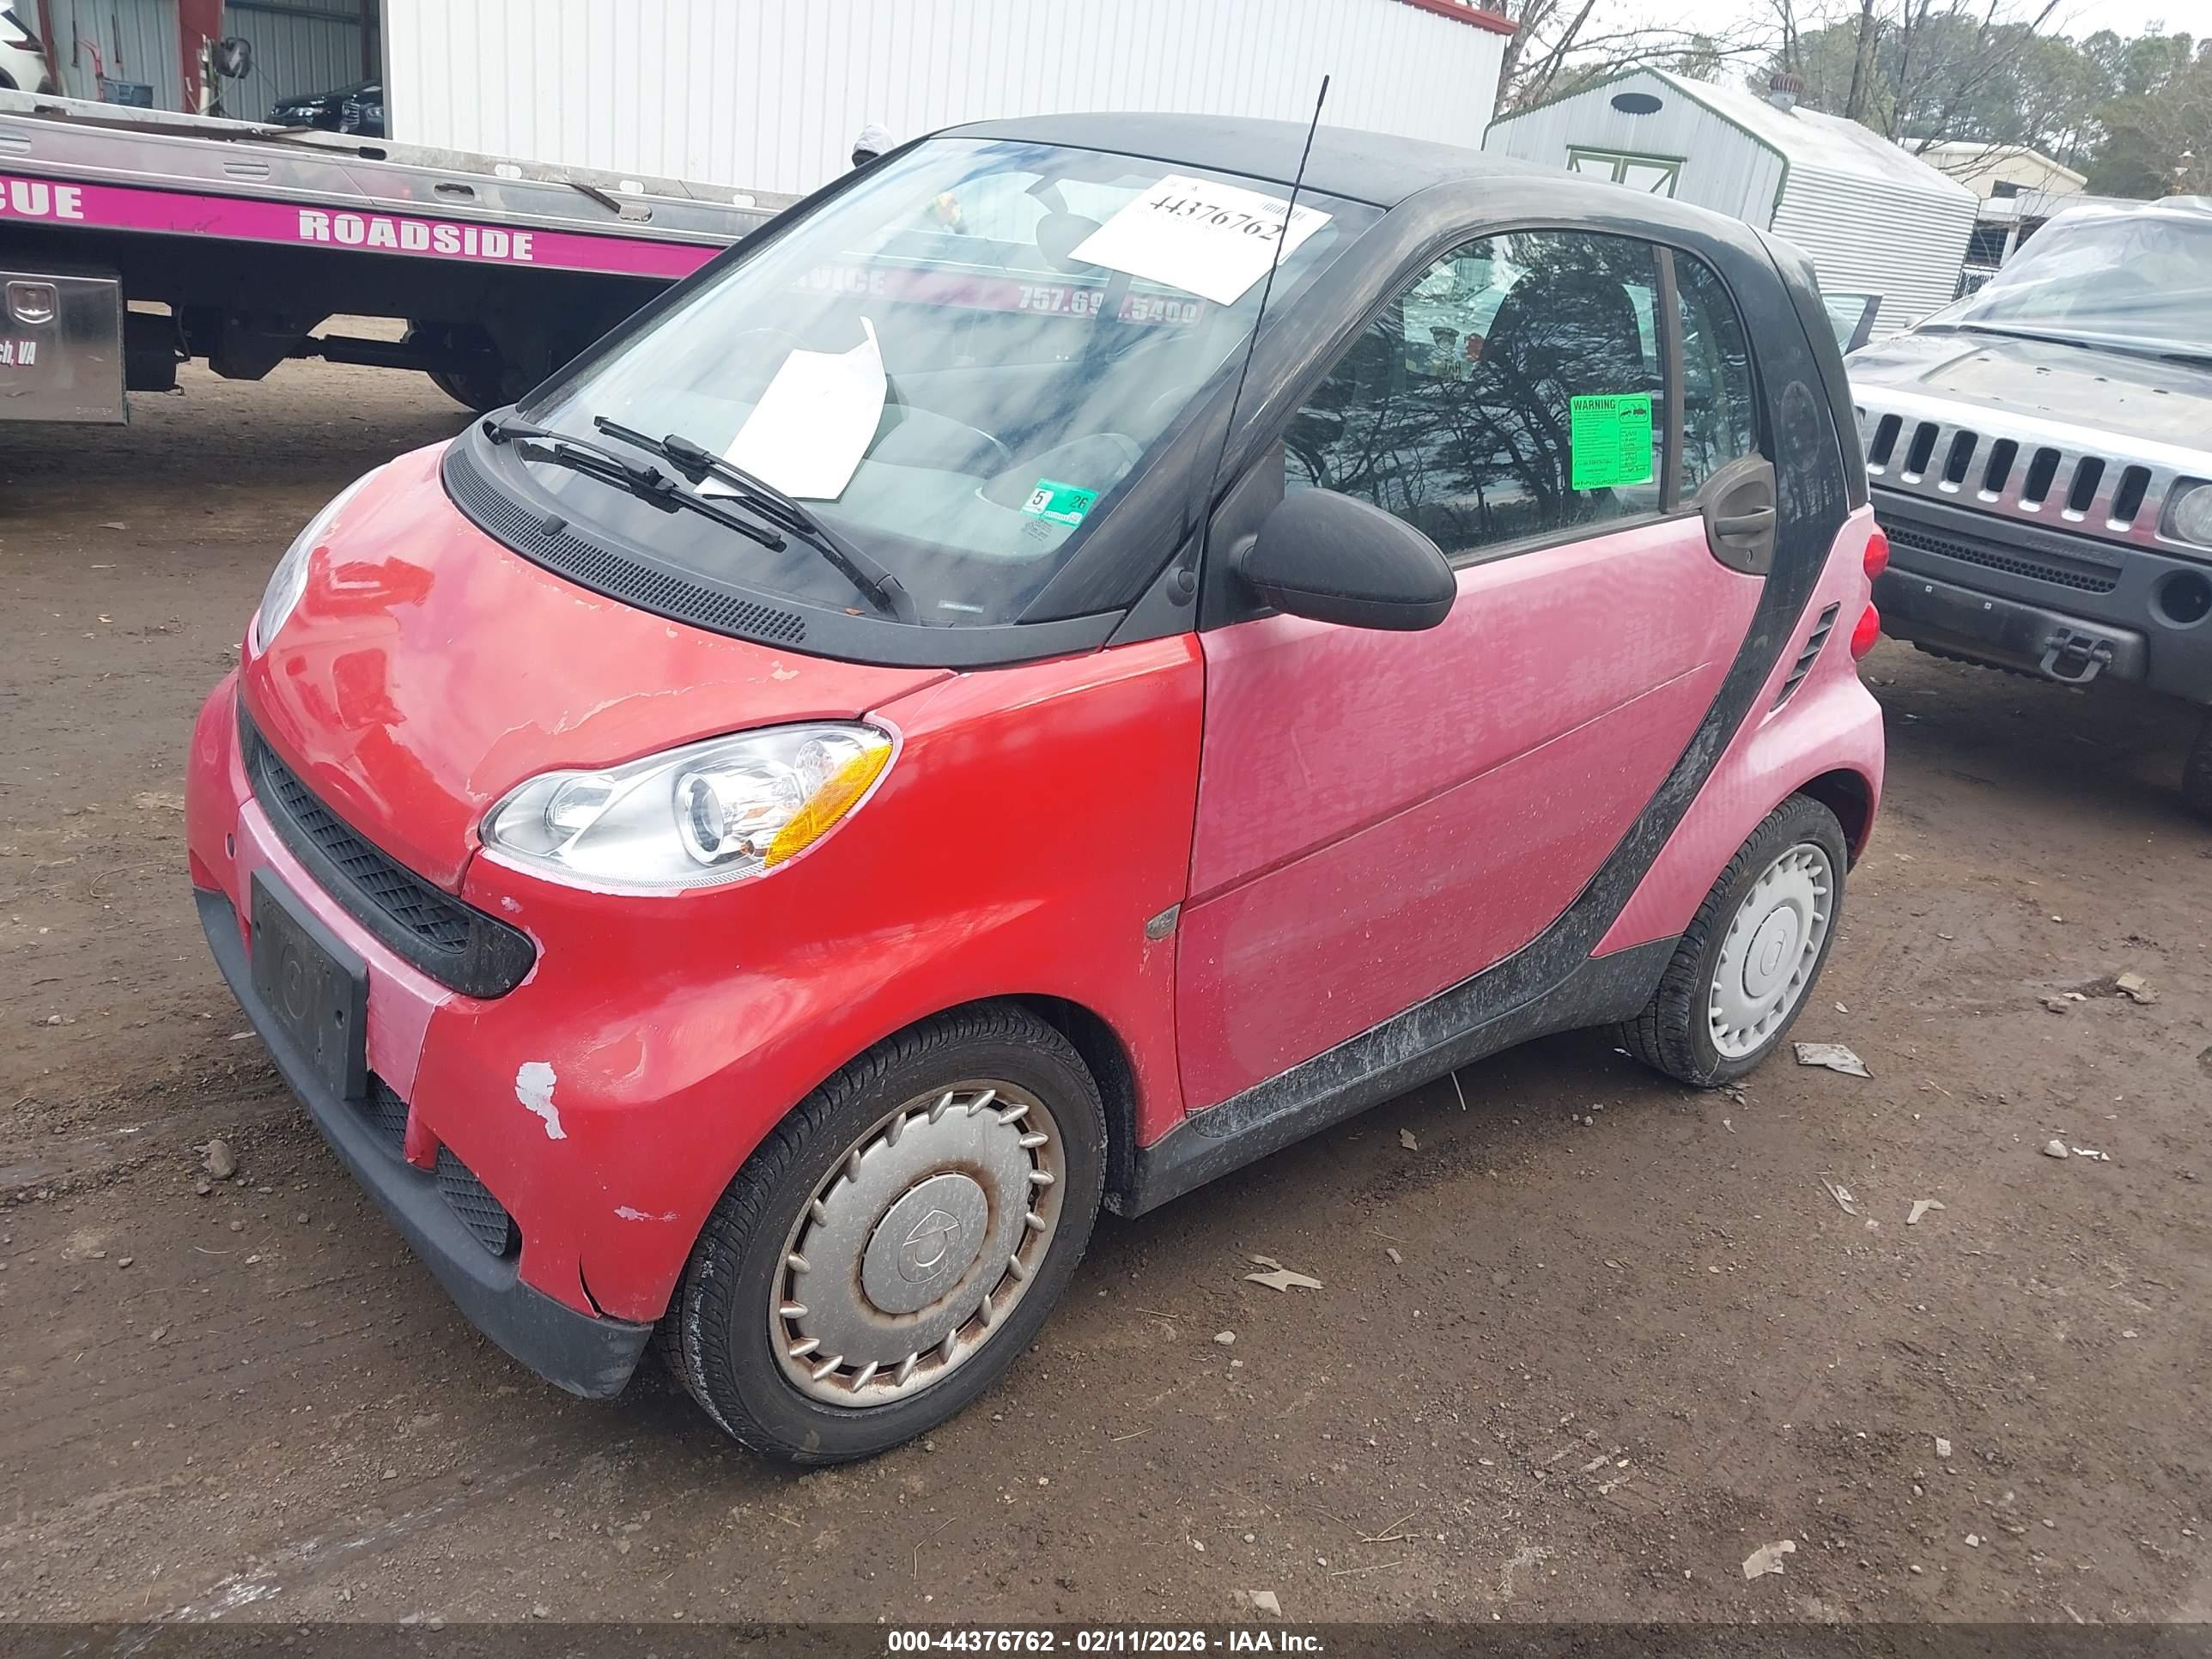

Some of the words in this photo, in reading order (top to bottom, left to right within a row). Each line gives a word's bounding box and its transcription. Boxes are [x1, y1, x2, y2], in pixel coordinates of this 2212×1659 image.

[0, 180, 85, 220] UE
[1150, 196, 1284, 240] 44376762
[299, 210, 533, 261] ROADSIDE
[1018, 286, 1197, 323] 757.69.5400
[17, 341, 37, 365] VA
[1573, 399, 1616, 411] WARNING
[1032, 490, 1046, 506] 5
[1070, 495, 1089, 508] 26
